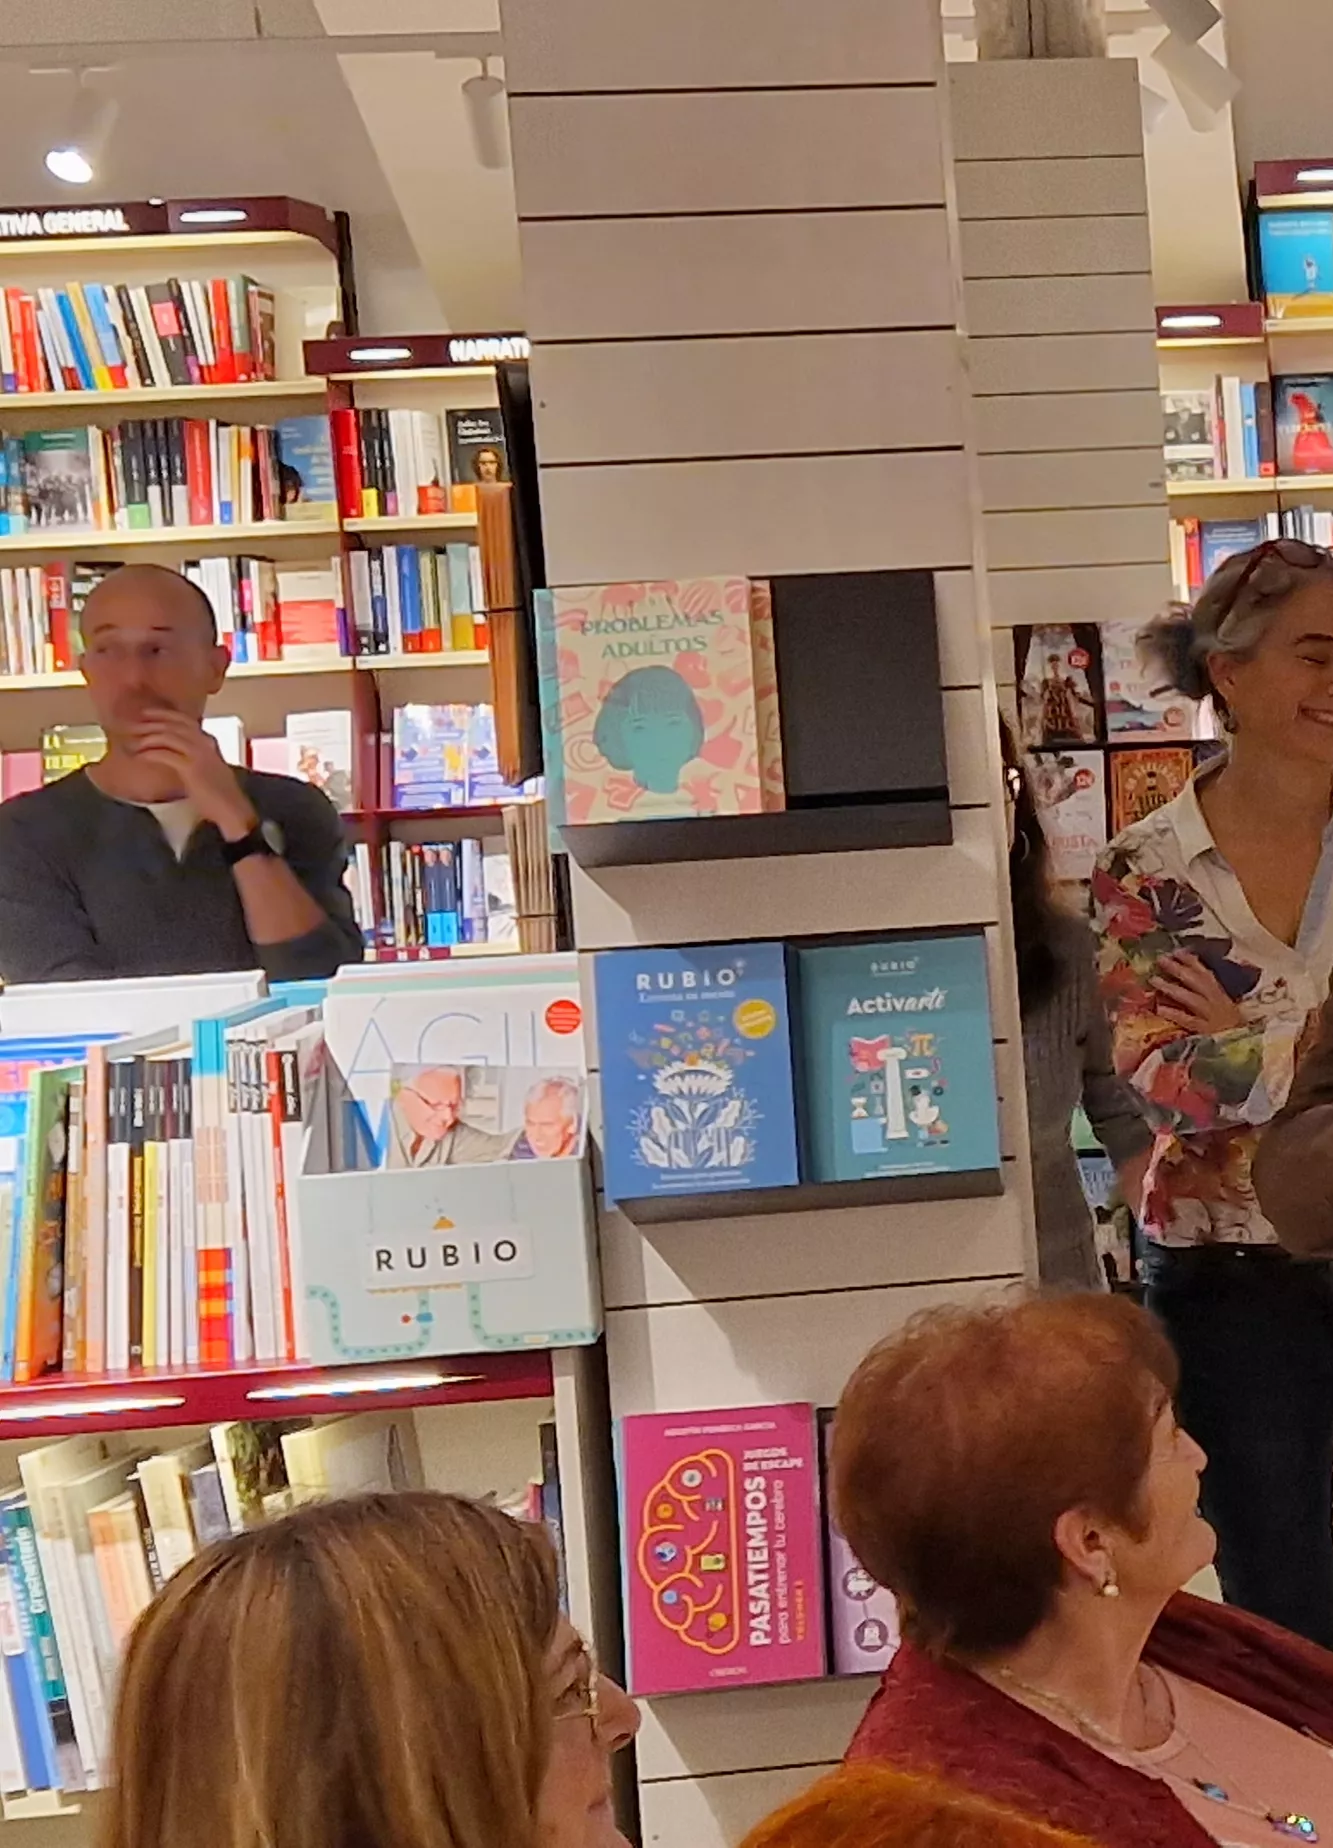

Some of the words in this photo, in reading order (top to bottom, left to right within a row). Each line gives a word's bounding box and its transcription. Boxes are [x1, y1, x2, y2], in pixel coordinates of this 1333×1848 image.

[43, 208, 130, 235] GENERAL
[580, 609, 725, 637] PROBLEMAS
[602, 634, 708, 659] ADULTOS
[636, 968, 736, 991] RUBIO
[375, 1240, 517, 1271] RUBIO
[743, 1475, 772, 1647] PASATIEMPOS
